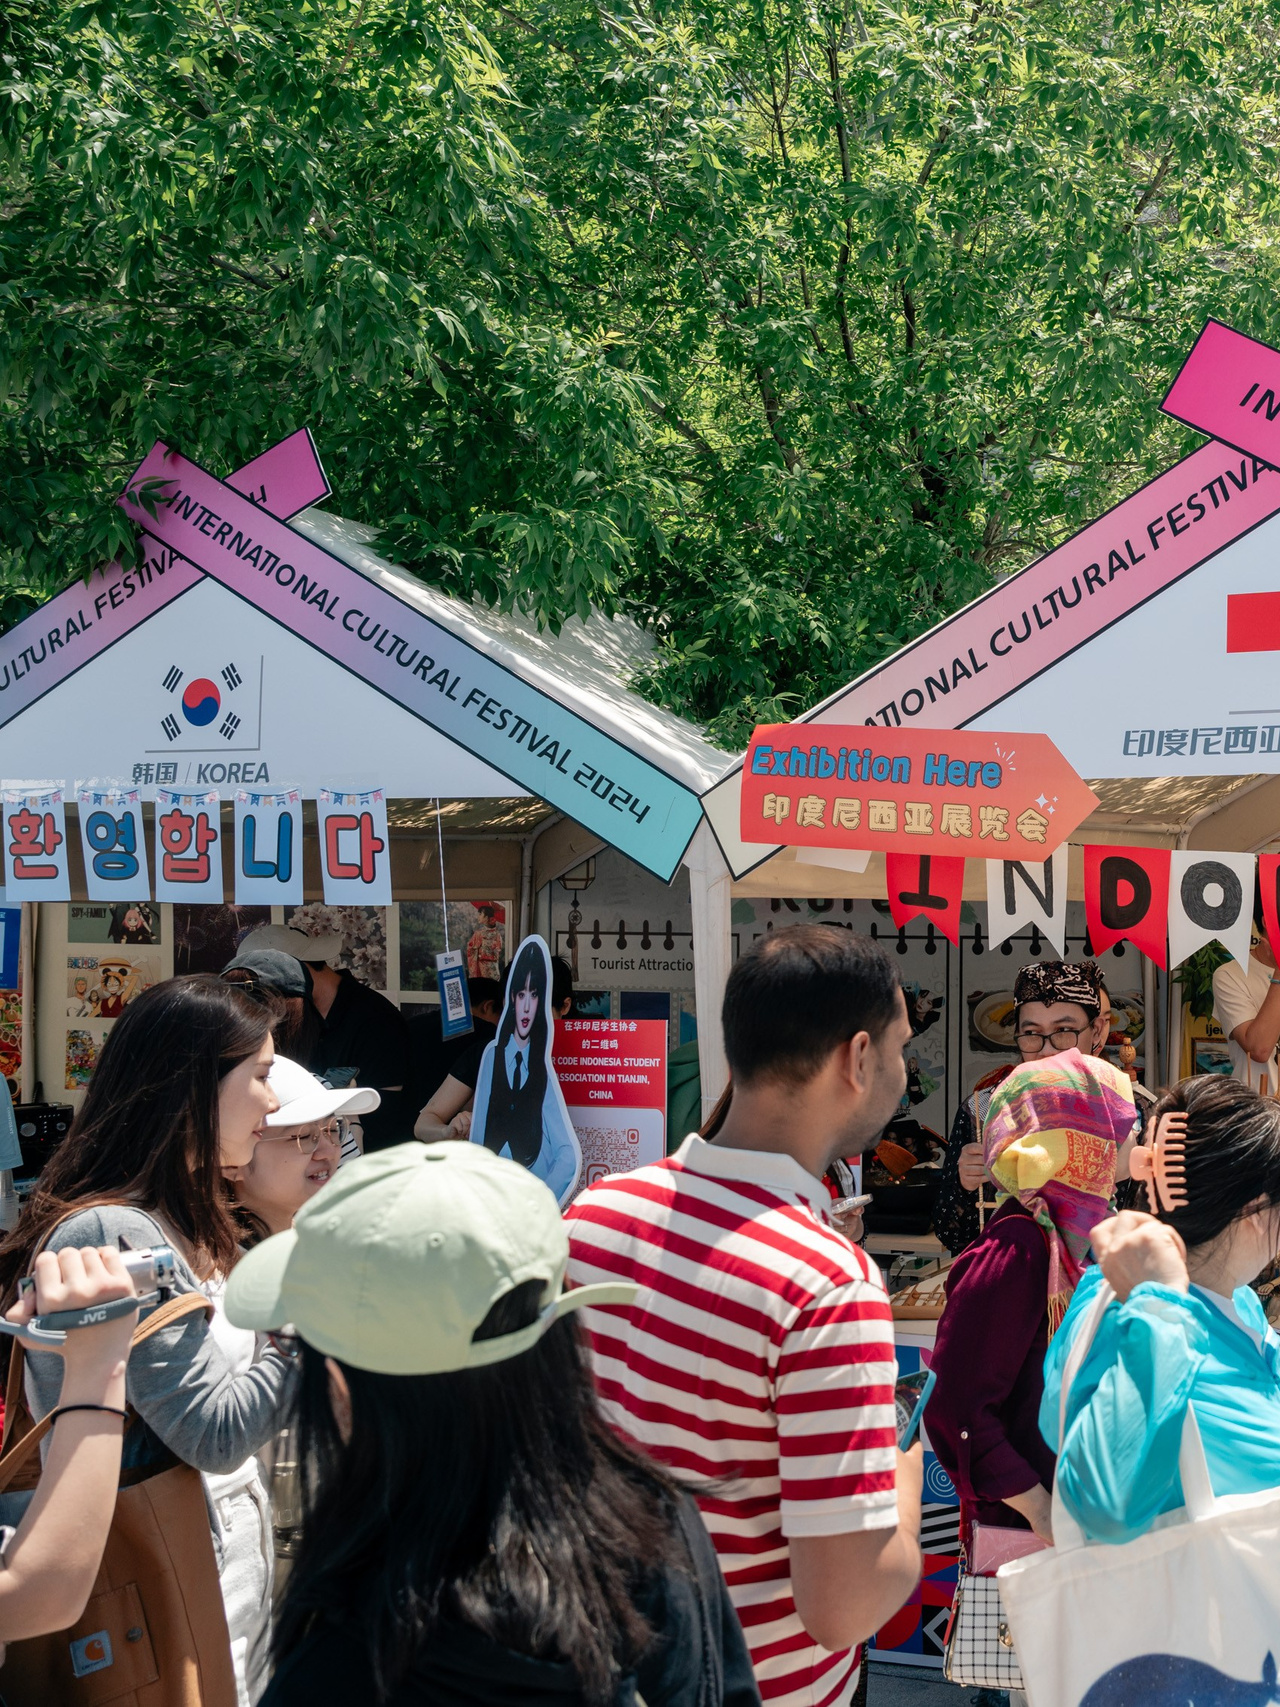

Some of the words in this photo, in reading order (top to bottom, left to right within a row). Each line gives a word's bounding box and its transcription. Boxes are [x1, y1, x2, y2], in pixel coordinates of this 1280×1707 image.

[990, 540, 1146, 656] CULTURAL
[165, 489, 341, 620] INTERNATIONAL
[342, 609, 462, 701] CULTURAL
[461, 687, 572, 775] FESTIVAL
[573, 762, 651, 824] 2024
[132, 762, 179, 785] 韩国
[197, 762, 270, 784] KOREA
[751, 745, 911, 784] Exhibition
[923, 753, 1003, 789] Here
[762, 792, 1050, 844] 印度尼西亚展览会
[8, 807, 385, 884] 환영합니다
[591, 957, 635, 971] Tourist
[564, 1021, 637, 1032] 在华印尼学生协会
[581, 1039, 618, 1050] 的二维码
[557, 1057, 578, 1065] CODE
[580, 1057, 621, 1067] INDONESIA
[623, 1058, 660, 1067] STUDENT
[607, 1074, 616, 1083] IN
[589, 1090, 613, 1099] CHINA
[79, 1310, 107, 1325] JVC
